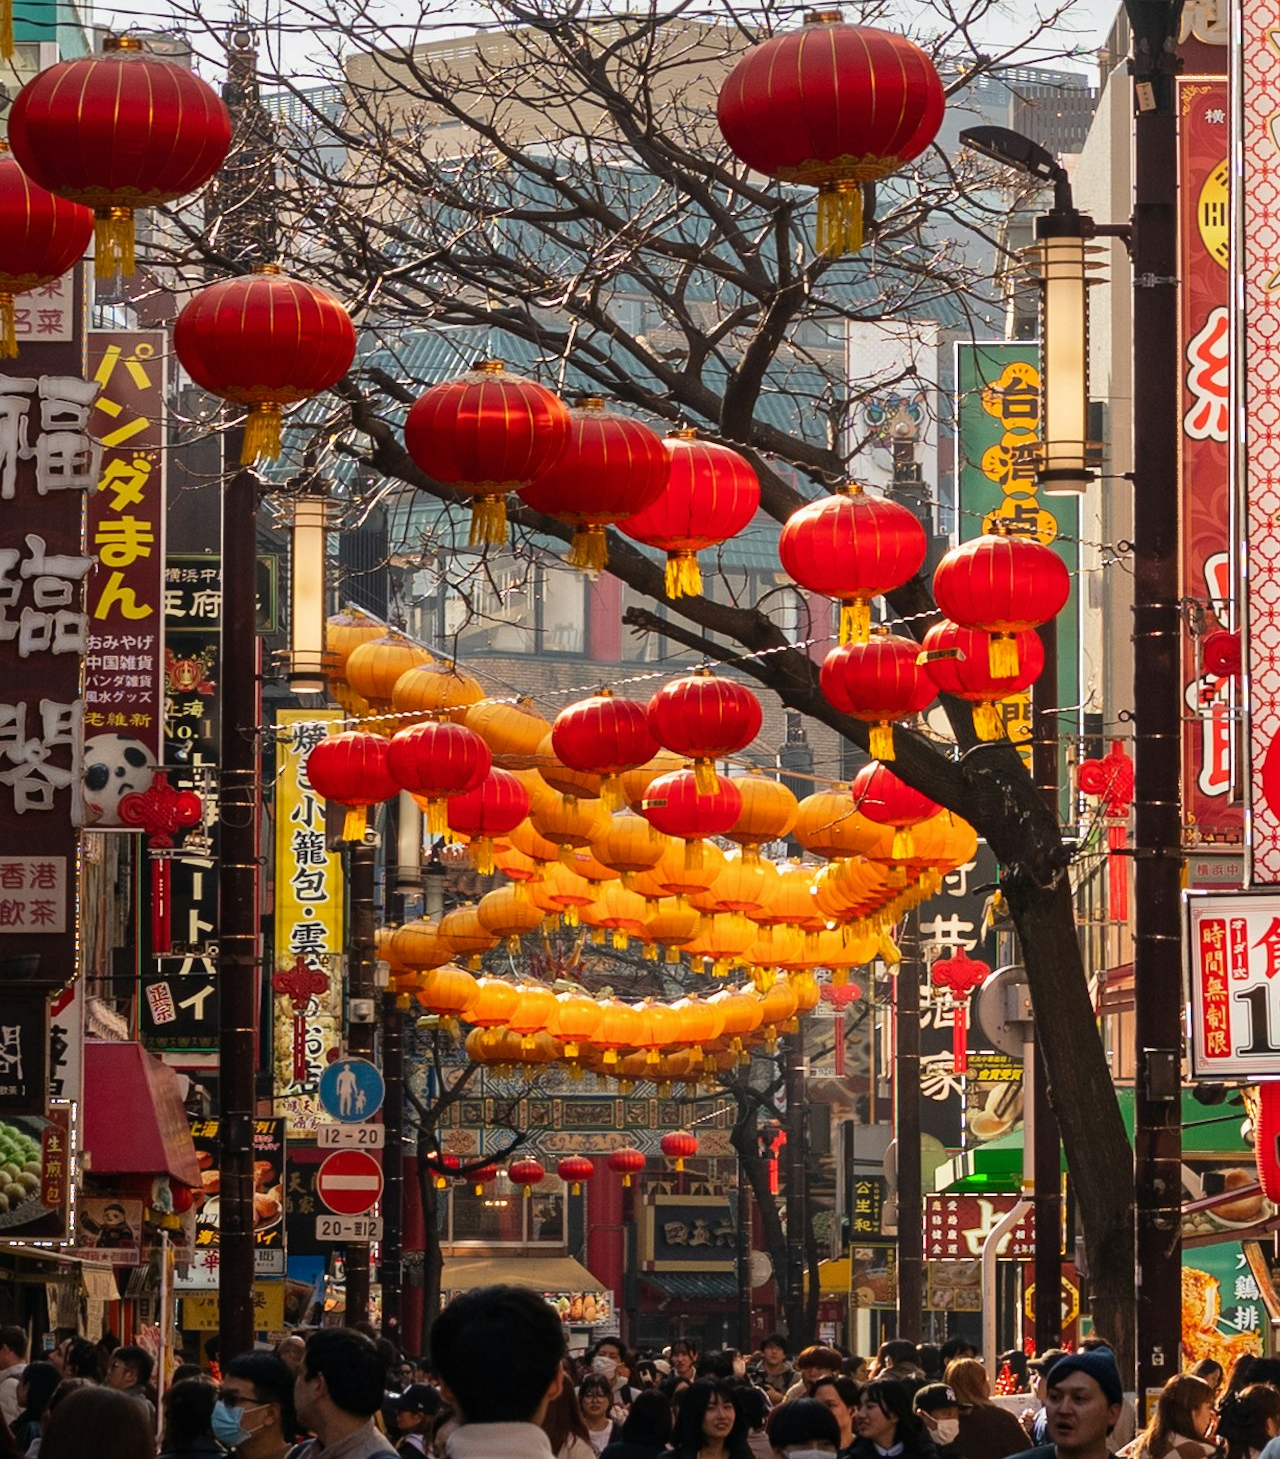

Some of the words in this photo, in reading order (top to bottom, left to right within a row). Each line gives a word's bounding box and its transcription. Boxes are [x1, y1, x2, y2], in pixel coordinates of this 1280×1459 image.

[92, 343, 155, 621] パンダまん
[165, 567, 222, 583] 横浜中
[87, 634, 155, 650] おみやげ
[86, 655, 153, 671] 中国雑貨
[86, 674, 152, 688] パンダ雑貨
[86, 690, 151, 704] 風水グッズ
[1231, 919, 1248, 979] オーダー式
[1203, 922, 1230, 1054] 時間無制限
